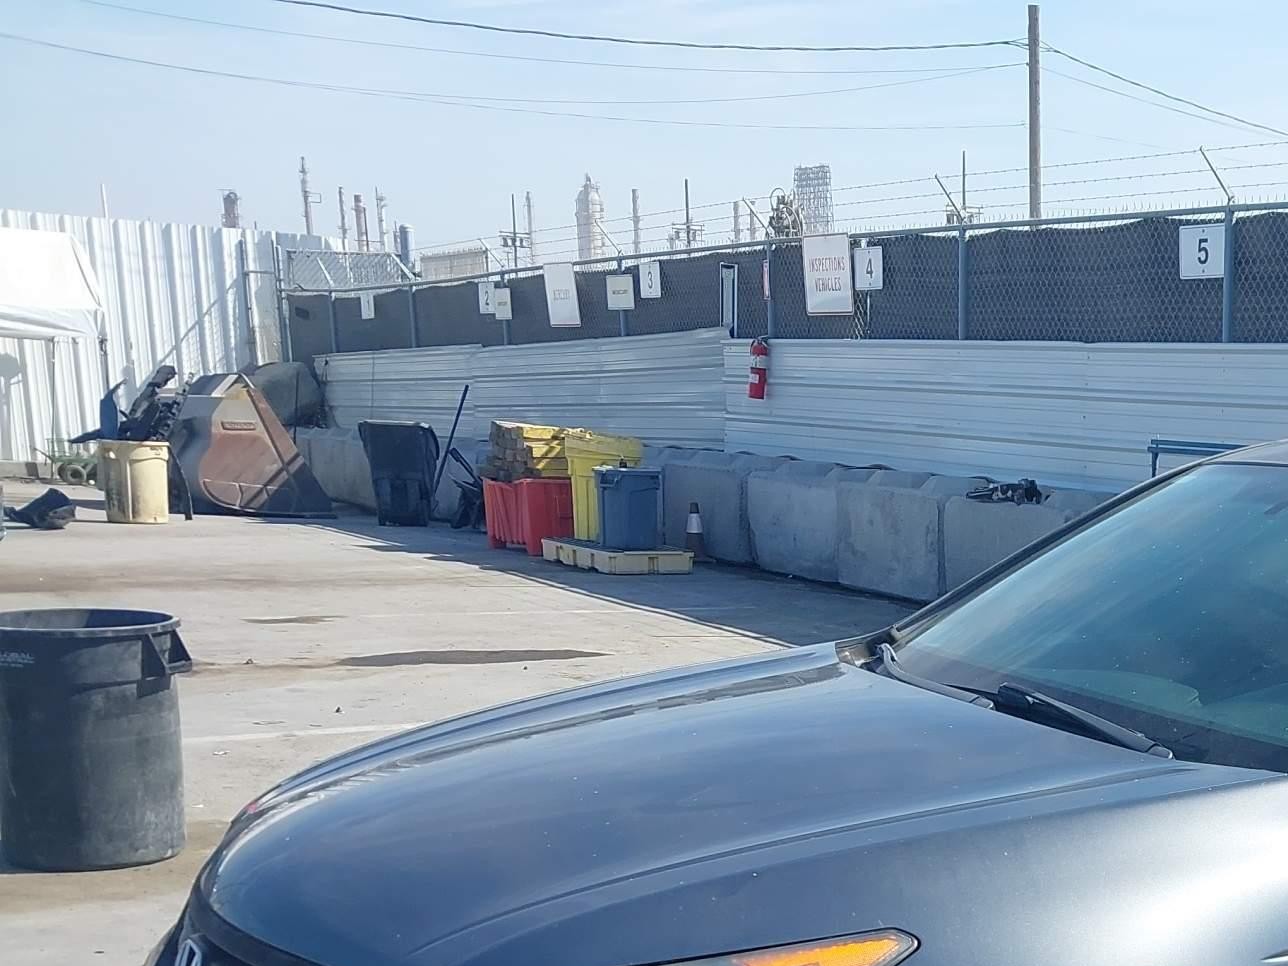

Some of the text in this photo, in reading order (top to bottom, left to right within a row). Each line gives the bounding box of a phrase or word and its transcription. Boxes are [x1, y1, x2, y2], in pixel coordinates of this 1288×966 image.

[1197, 237, 1209, 265] 5
[809, 256, 846, 272] INSPECTIONS
[865, 258, 874, 279] 4
[647, 271, 653, 289] 3
[815, 276, 842, 292] VEHICLES
[484, 290, 490, 306] 2
